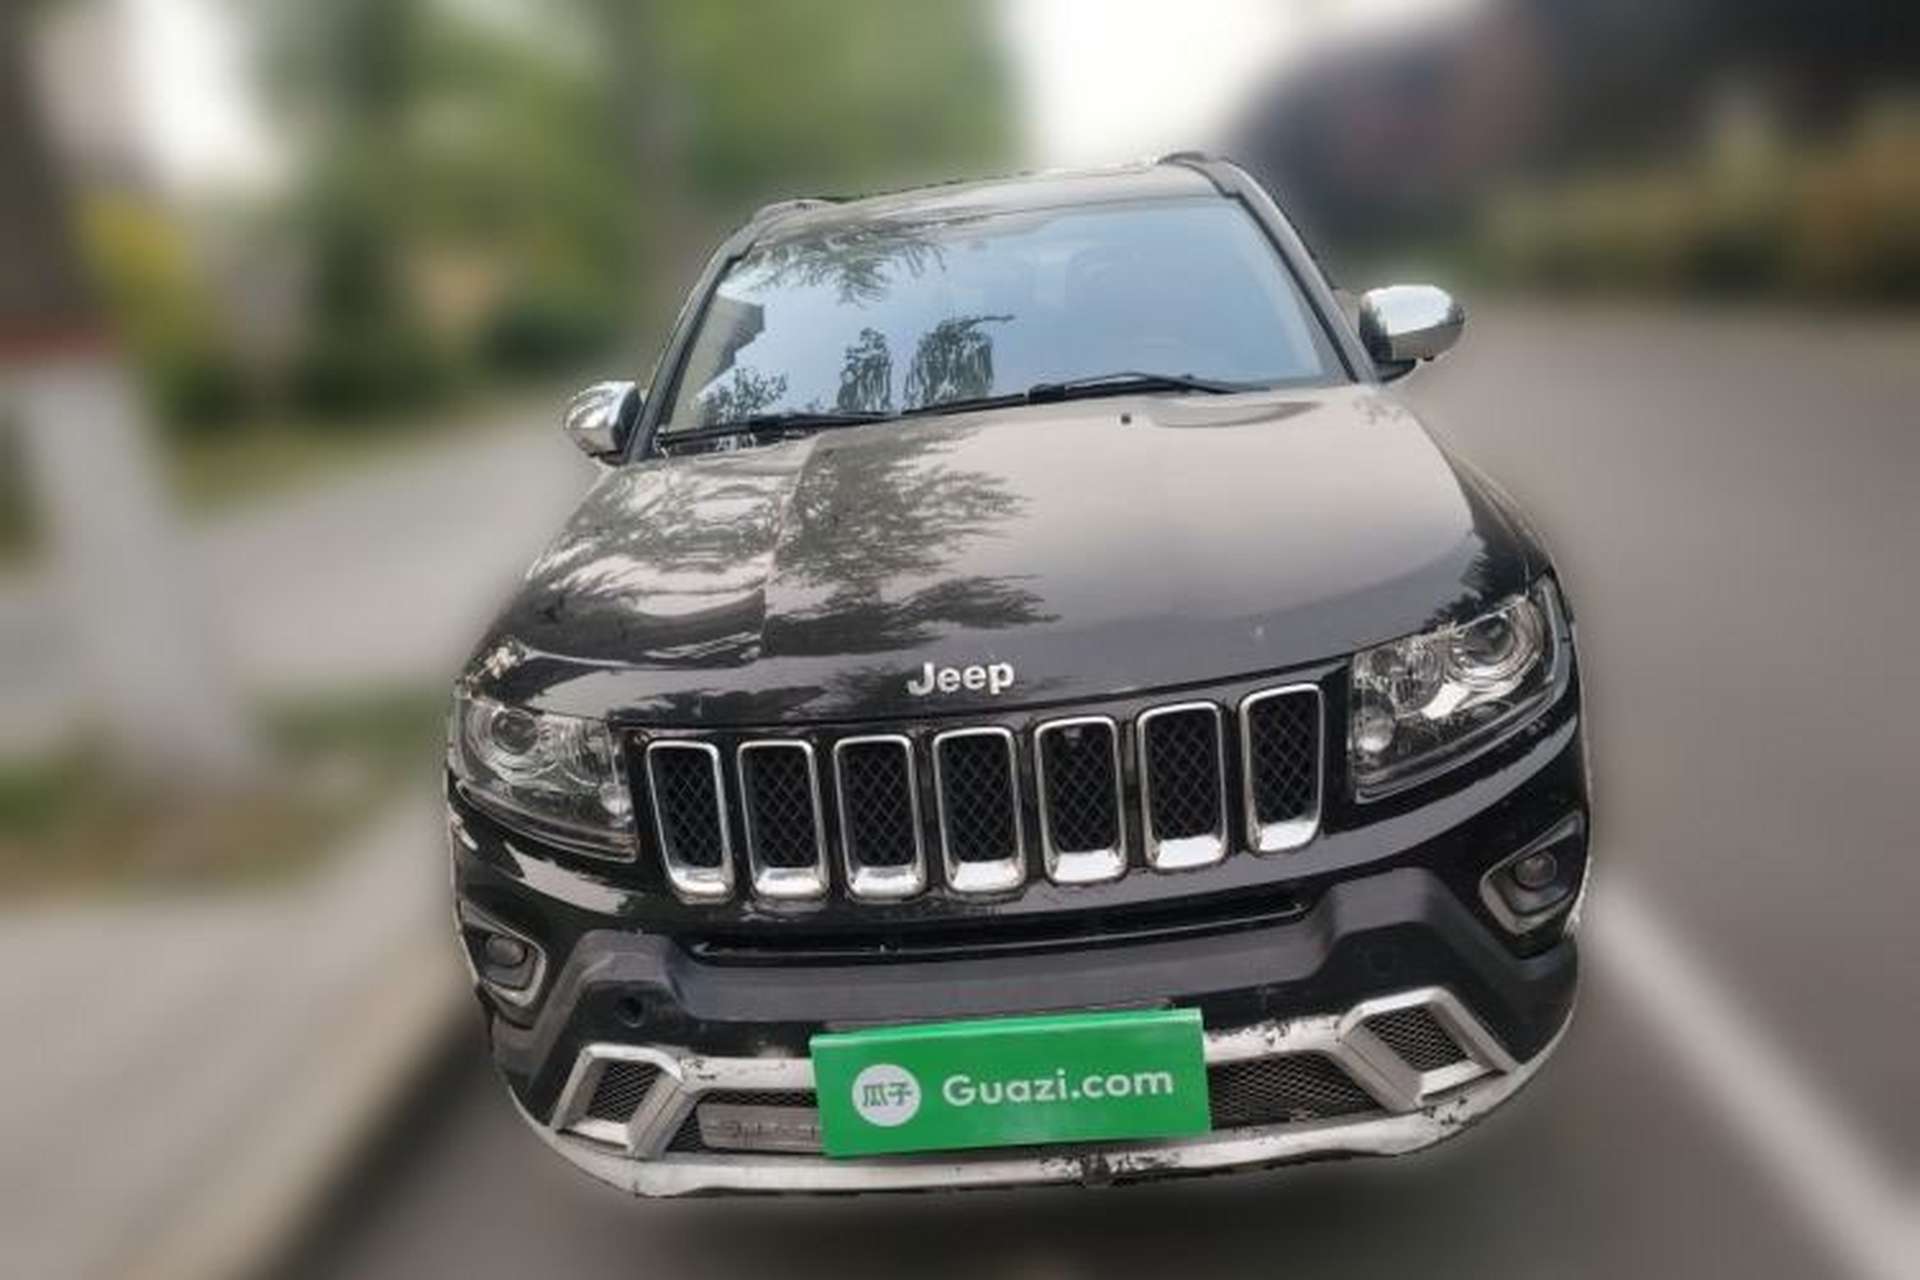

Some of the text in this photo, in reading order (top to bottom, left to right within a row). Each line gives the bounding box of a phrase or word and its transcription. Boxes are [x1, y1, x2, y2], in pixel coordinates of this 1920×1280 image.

[907, 661, 1014, 696] Jeep
[862, 1082, 913, 1107] 瓜子
[942, 1069, 1174, 1107] Guazi.com
